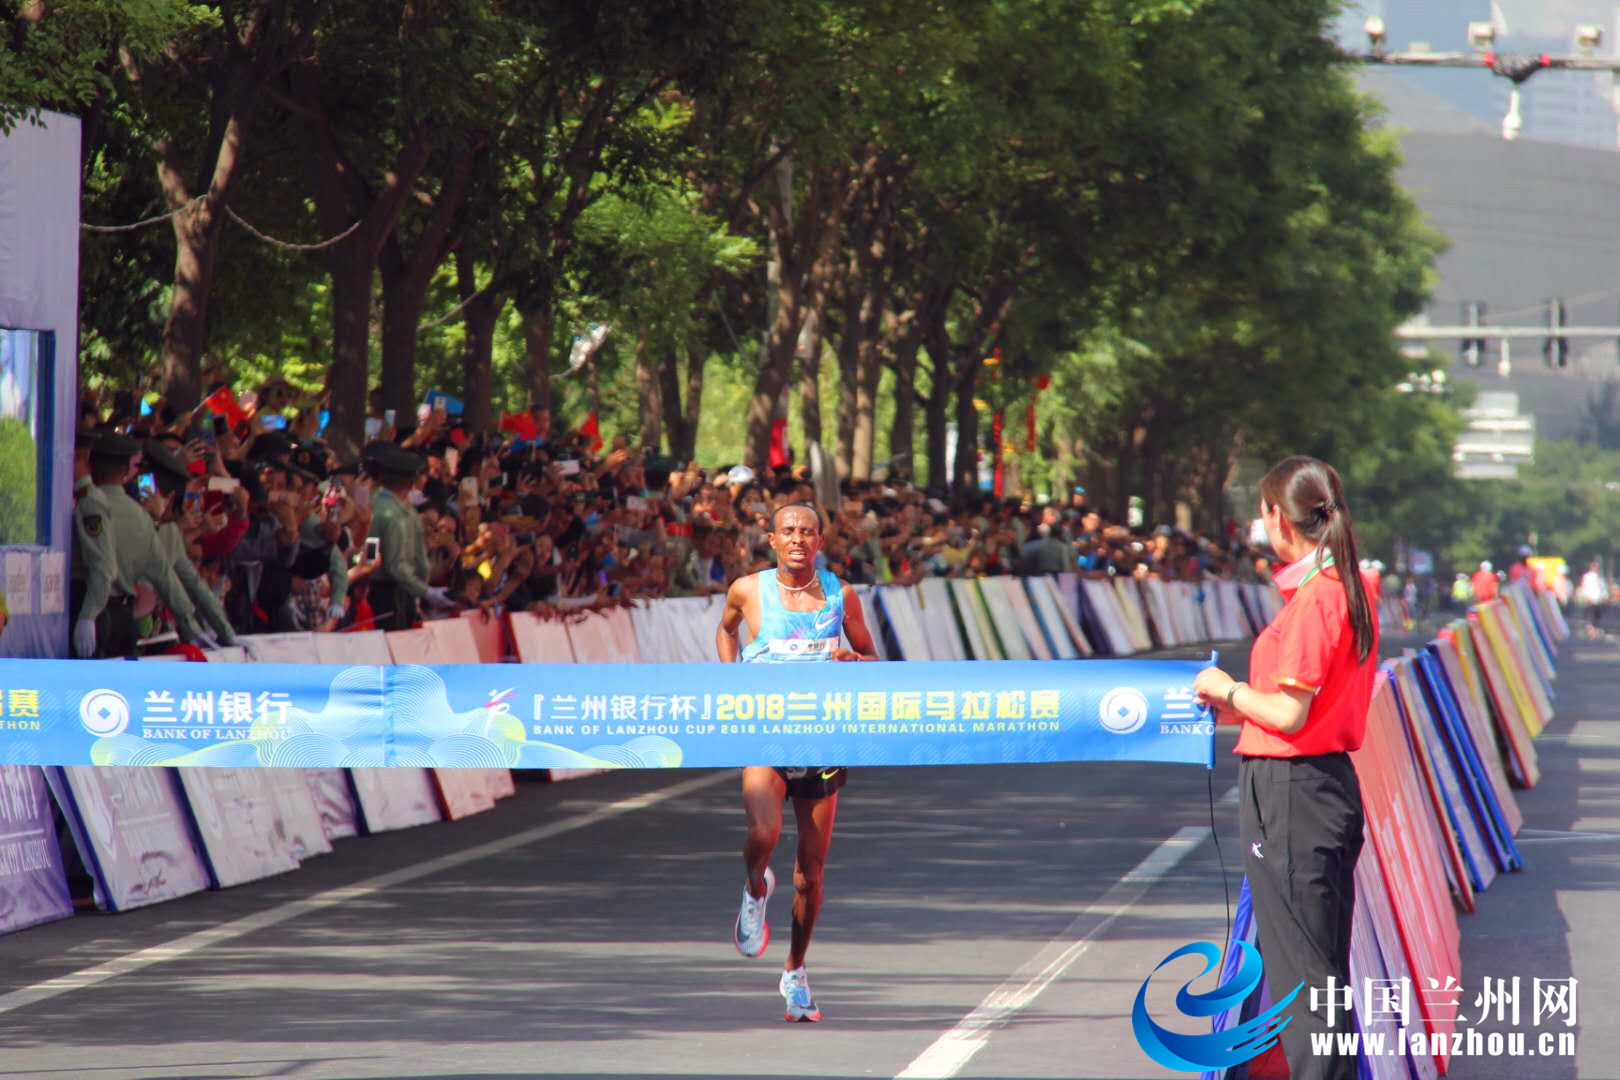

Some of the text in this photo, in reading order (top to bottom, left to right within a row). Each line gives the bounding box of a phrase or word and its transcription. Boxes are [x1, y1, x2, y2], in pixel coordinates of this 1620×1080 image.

[0, 689, 40, 717] 赛
[143, 690, 292, 724] 兰州银行
[143, 728, 290, 740] BANK OF LANZHOU
[533, 720, 1060, 735] BANK OF LANZHOU CUP 2018 LANZHOU INTERNATIONAL MARATHON
[1160, 724, 1201, 735] BANK
